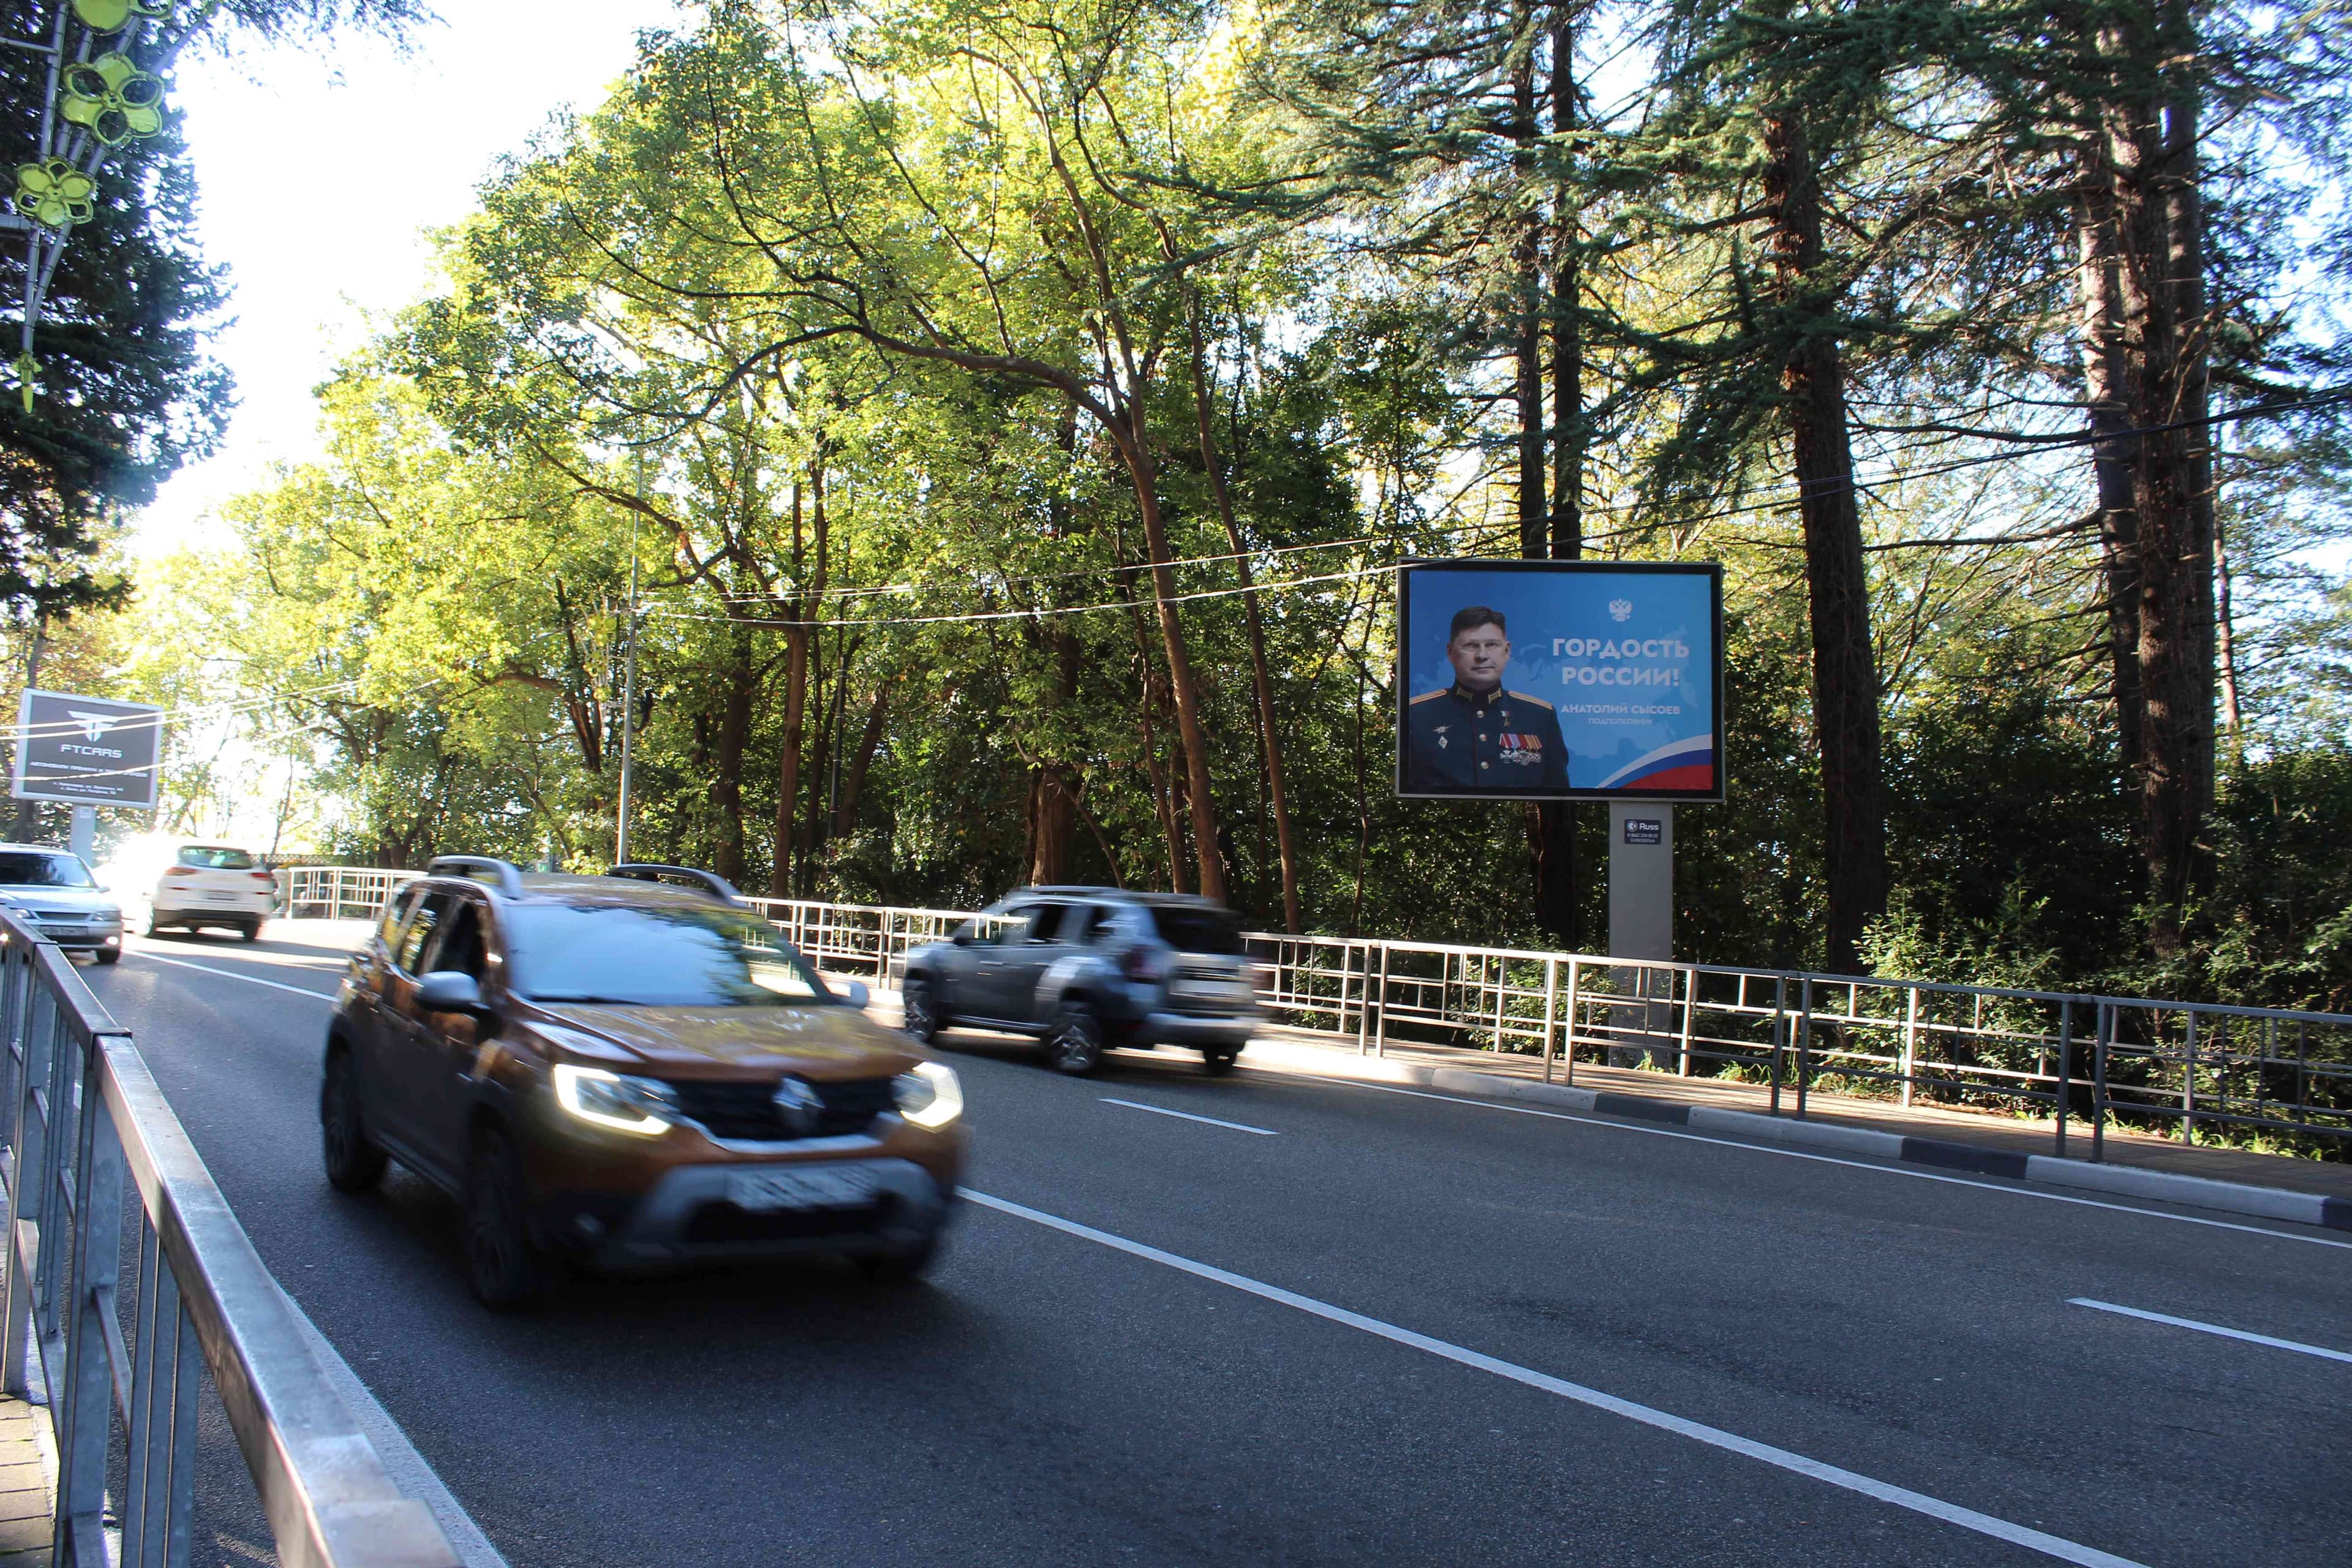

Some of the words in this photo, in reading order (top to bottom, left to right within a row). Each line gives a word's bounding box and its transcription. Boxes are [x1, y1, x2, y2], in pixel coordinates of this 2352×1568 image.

[1553, 638, 1689, 660] ГОРДОСТЬ
[1562, 667, 1680, 687] РОССИИ!
[1561, 703, 1628, 714] АНАТОЛИЙ
[1631, 704, 1681, 715] СЫСОЕВ
[61, 744, 123, 759] FTCARS
